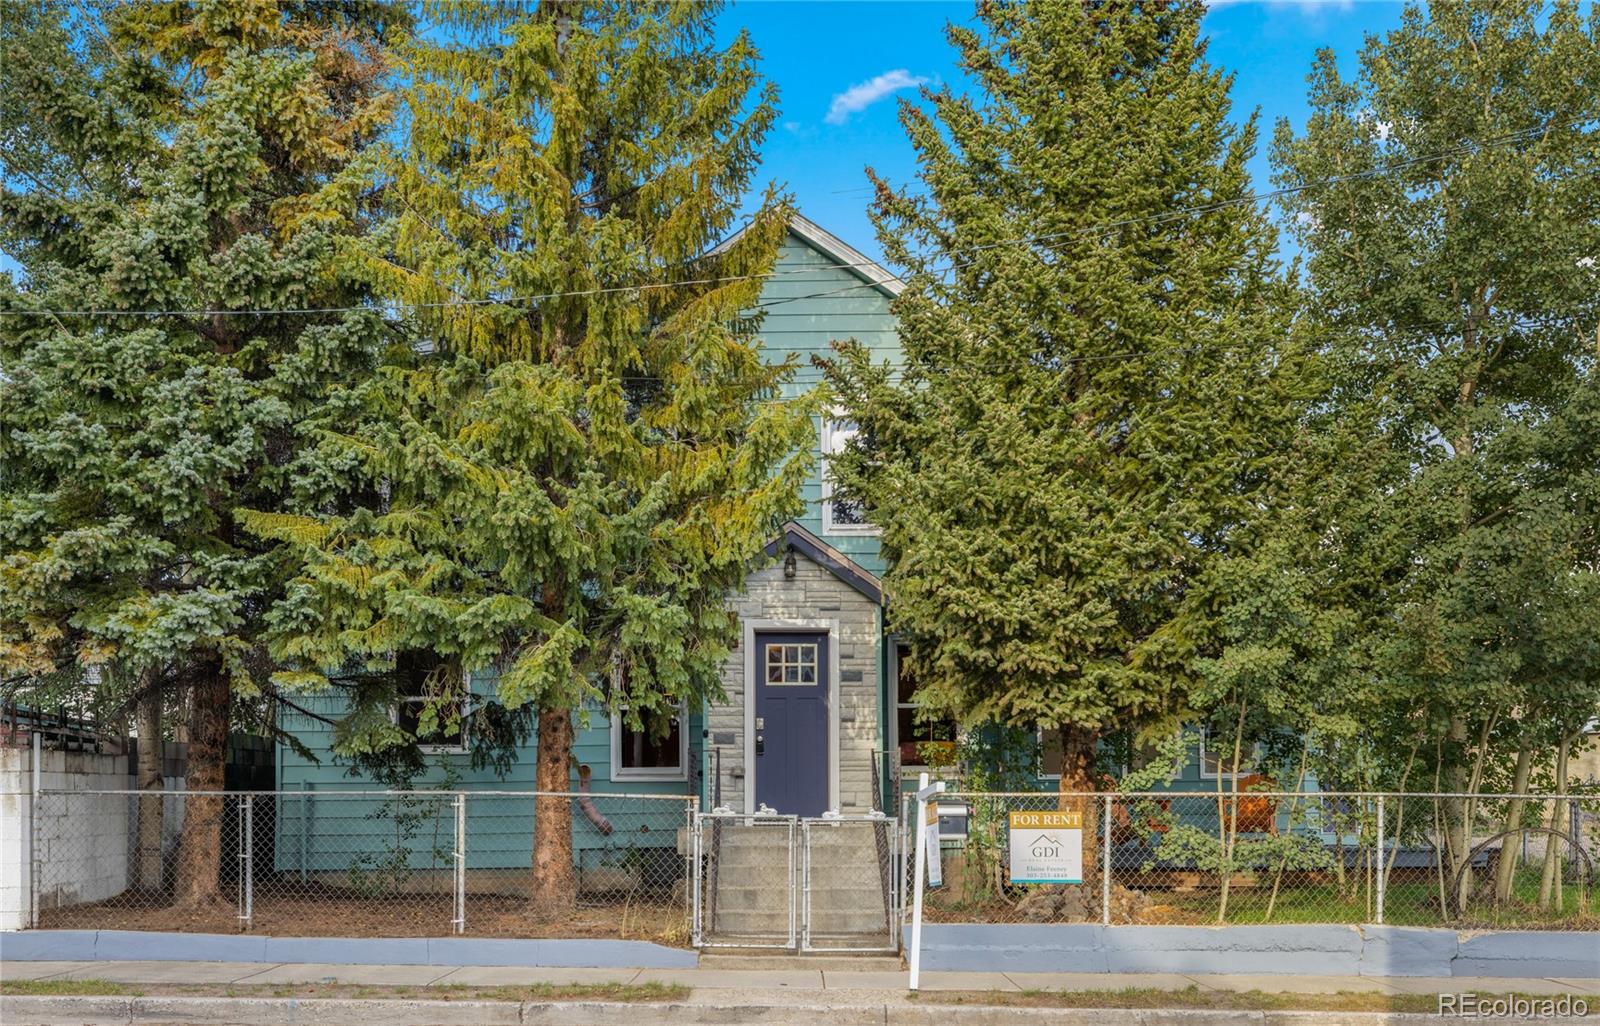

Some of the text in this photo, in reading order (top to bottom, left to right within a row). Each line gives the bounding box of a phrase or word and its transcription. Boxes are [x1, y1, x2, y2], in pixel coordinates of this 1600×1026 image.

[1013, 815, 1081, 825] FOR RENT
[1032, 847, 1059, 858] GDI
